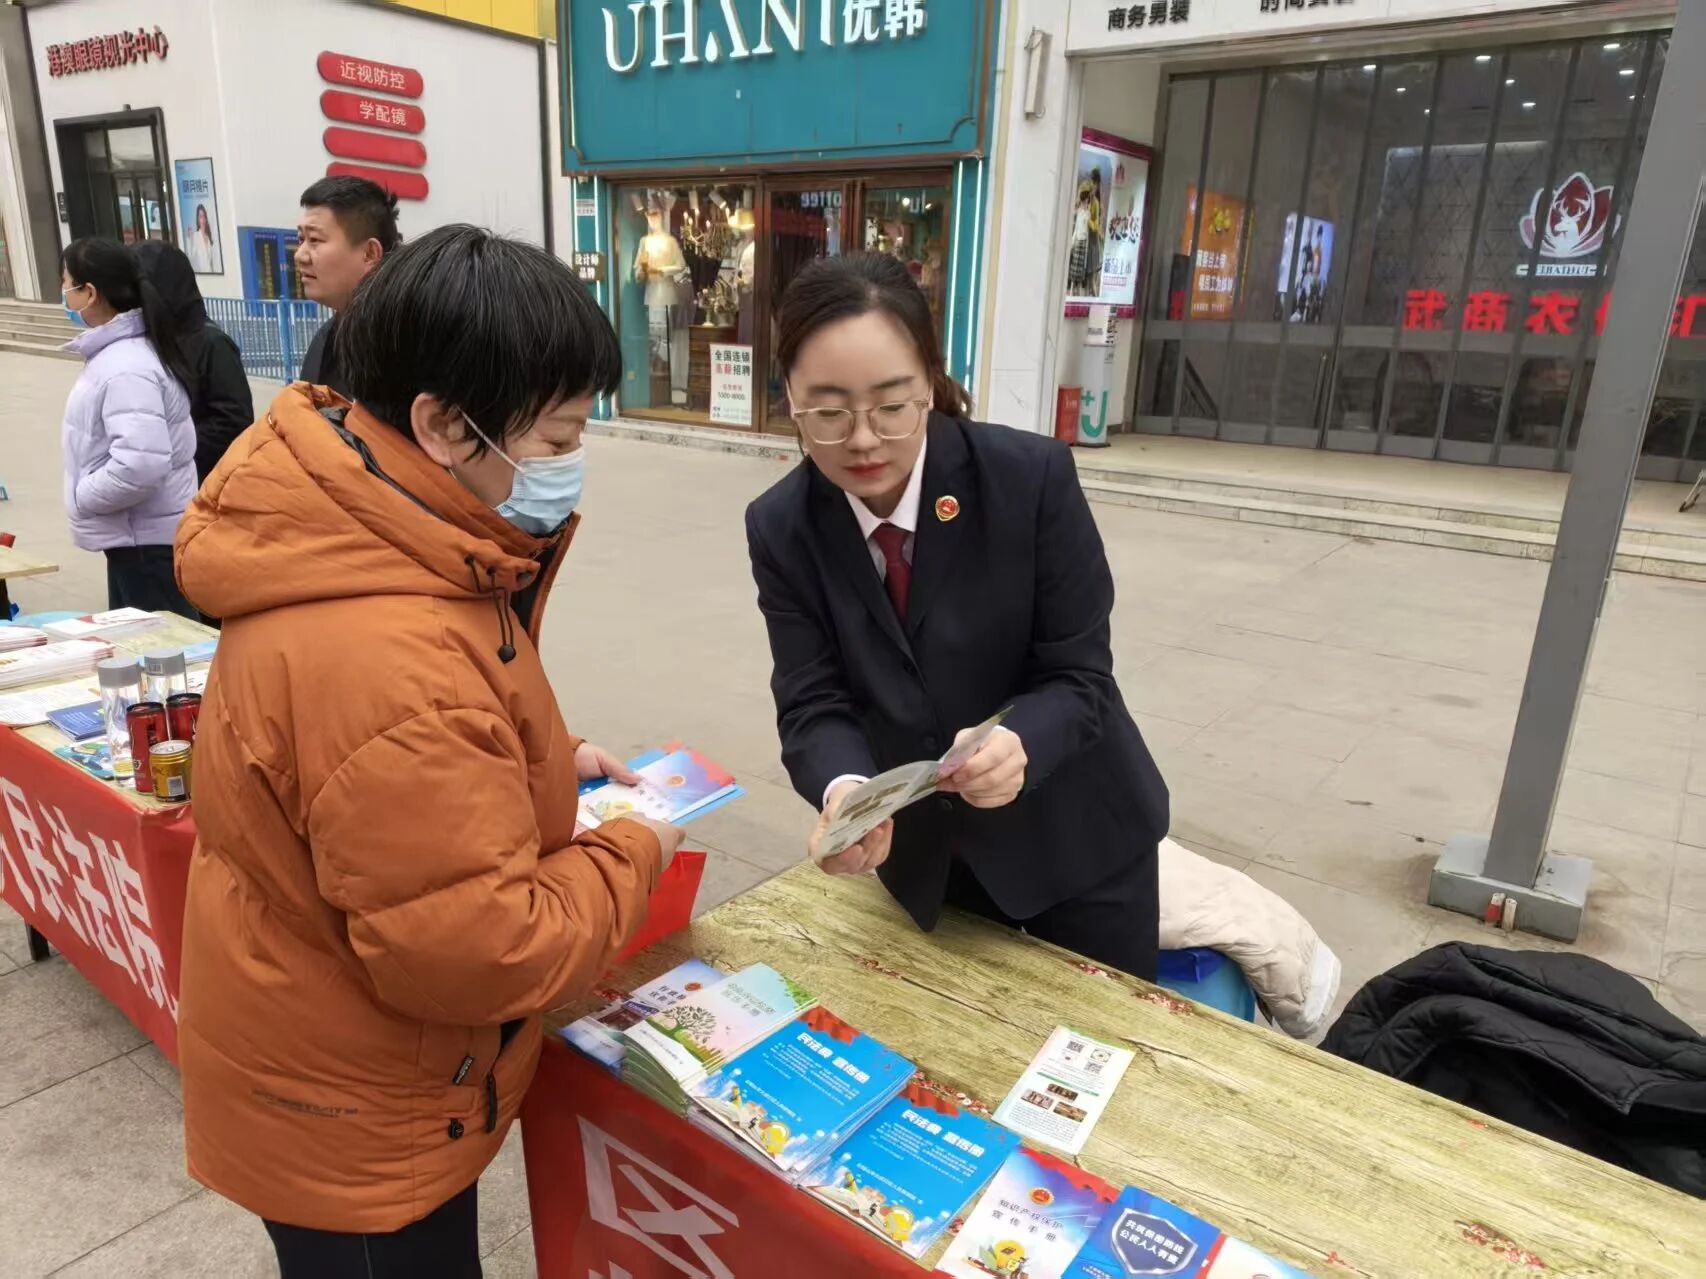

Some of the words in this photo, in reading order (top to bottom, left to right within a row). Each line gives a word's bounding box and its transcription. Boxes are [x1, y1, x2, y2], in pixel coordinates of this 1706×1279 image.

[842, 0, 926, 43] 优韩
[1107, 0, 1189, 31] 商务男装
[340, 60, 405, 89] 近视防控
[359, 100, 407, 126] 学配镜
[796, 1031, 834, 1059] 民法典
[901, 1108, 943, 1136] 民法典
[991, 1209, 1057, 1241] 宣传手册
[999, 1199, 1064, 1229] 知识产权保护
[1119, 1229, 1180, 1265] 公民人人有责
